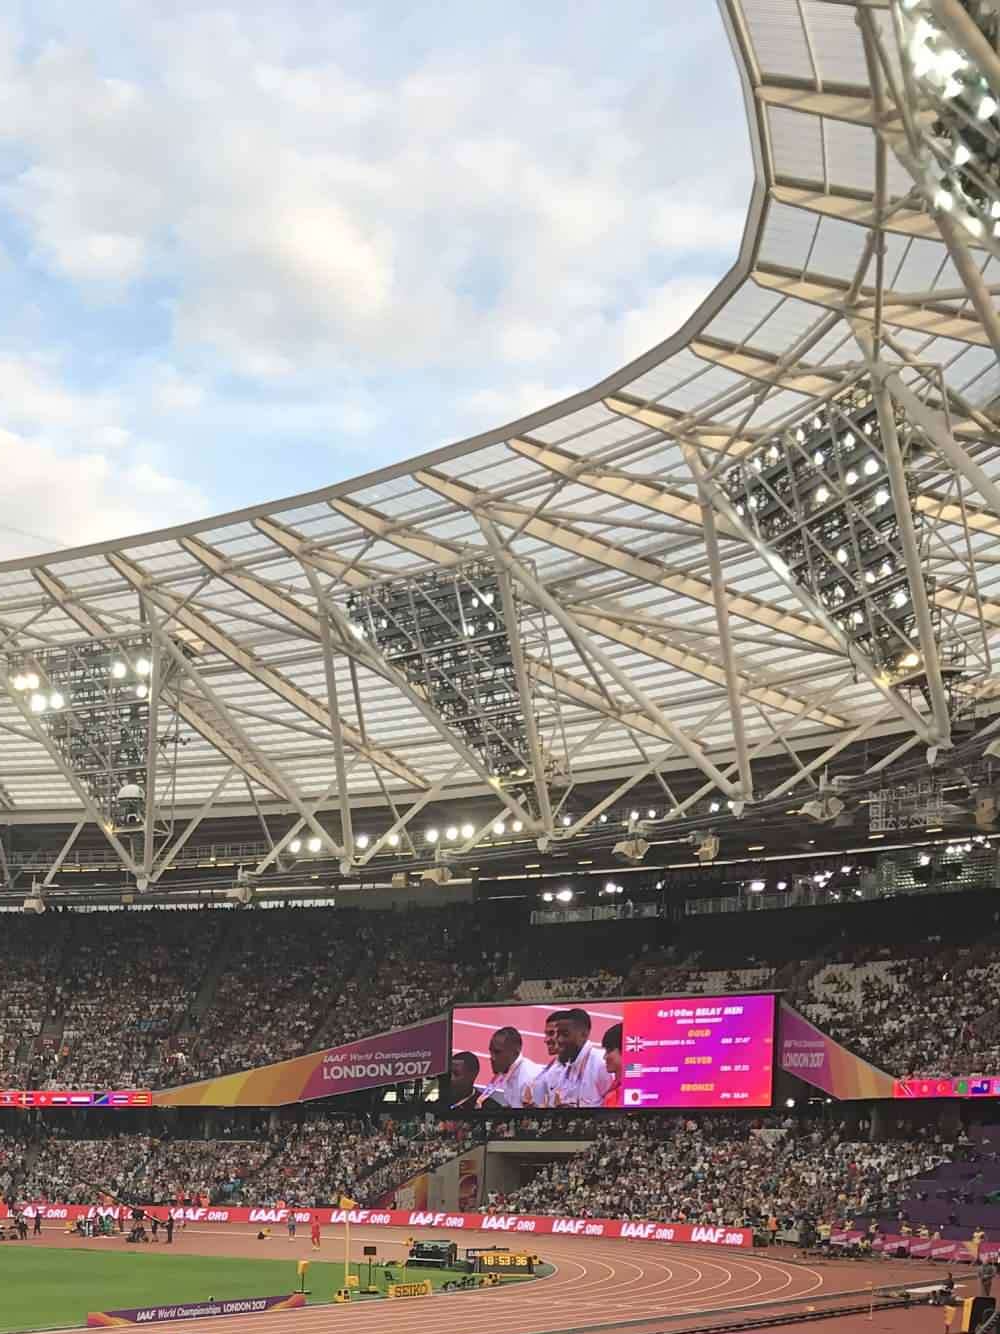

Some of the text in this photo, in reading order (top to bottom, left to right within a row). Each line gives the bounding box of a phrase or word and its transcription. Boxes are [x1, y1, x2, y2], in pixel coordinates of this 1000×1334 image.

[323, 1053, 348, 1063] IAAF
[350, 1051, 373, 1061] World
[323, 1061, 432, 1080] LONDON 2017
[408, 1211, 464, 1228] IAAF.ORG
[481, 1215, 535, 1231] IAAF.ORG
[552, 1219, 604, 1235] IAAF.ORG
[620, 1222, 674, 1240] IAAF.ORG
[691, 1226, 744, 1245] IAAF.ORG
[394, 1283, 428, 1297] SEIKO
[136, 1310, 156, 1321] IAAF
[158, 1308, 176, 1319] World
[177, 1305, 221, 1317] Championships
[223, 1302, 251, 1313] LONDON
